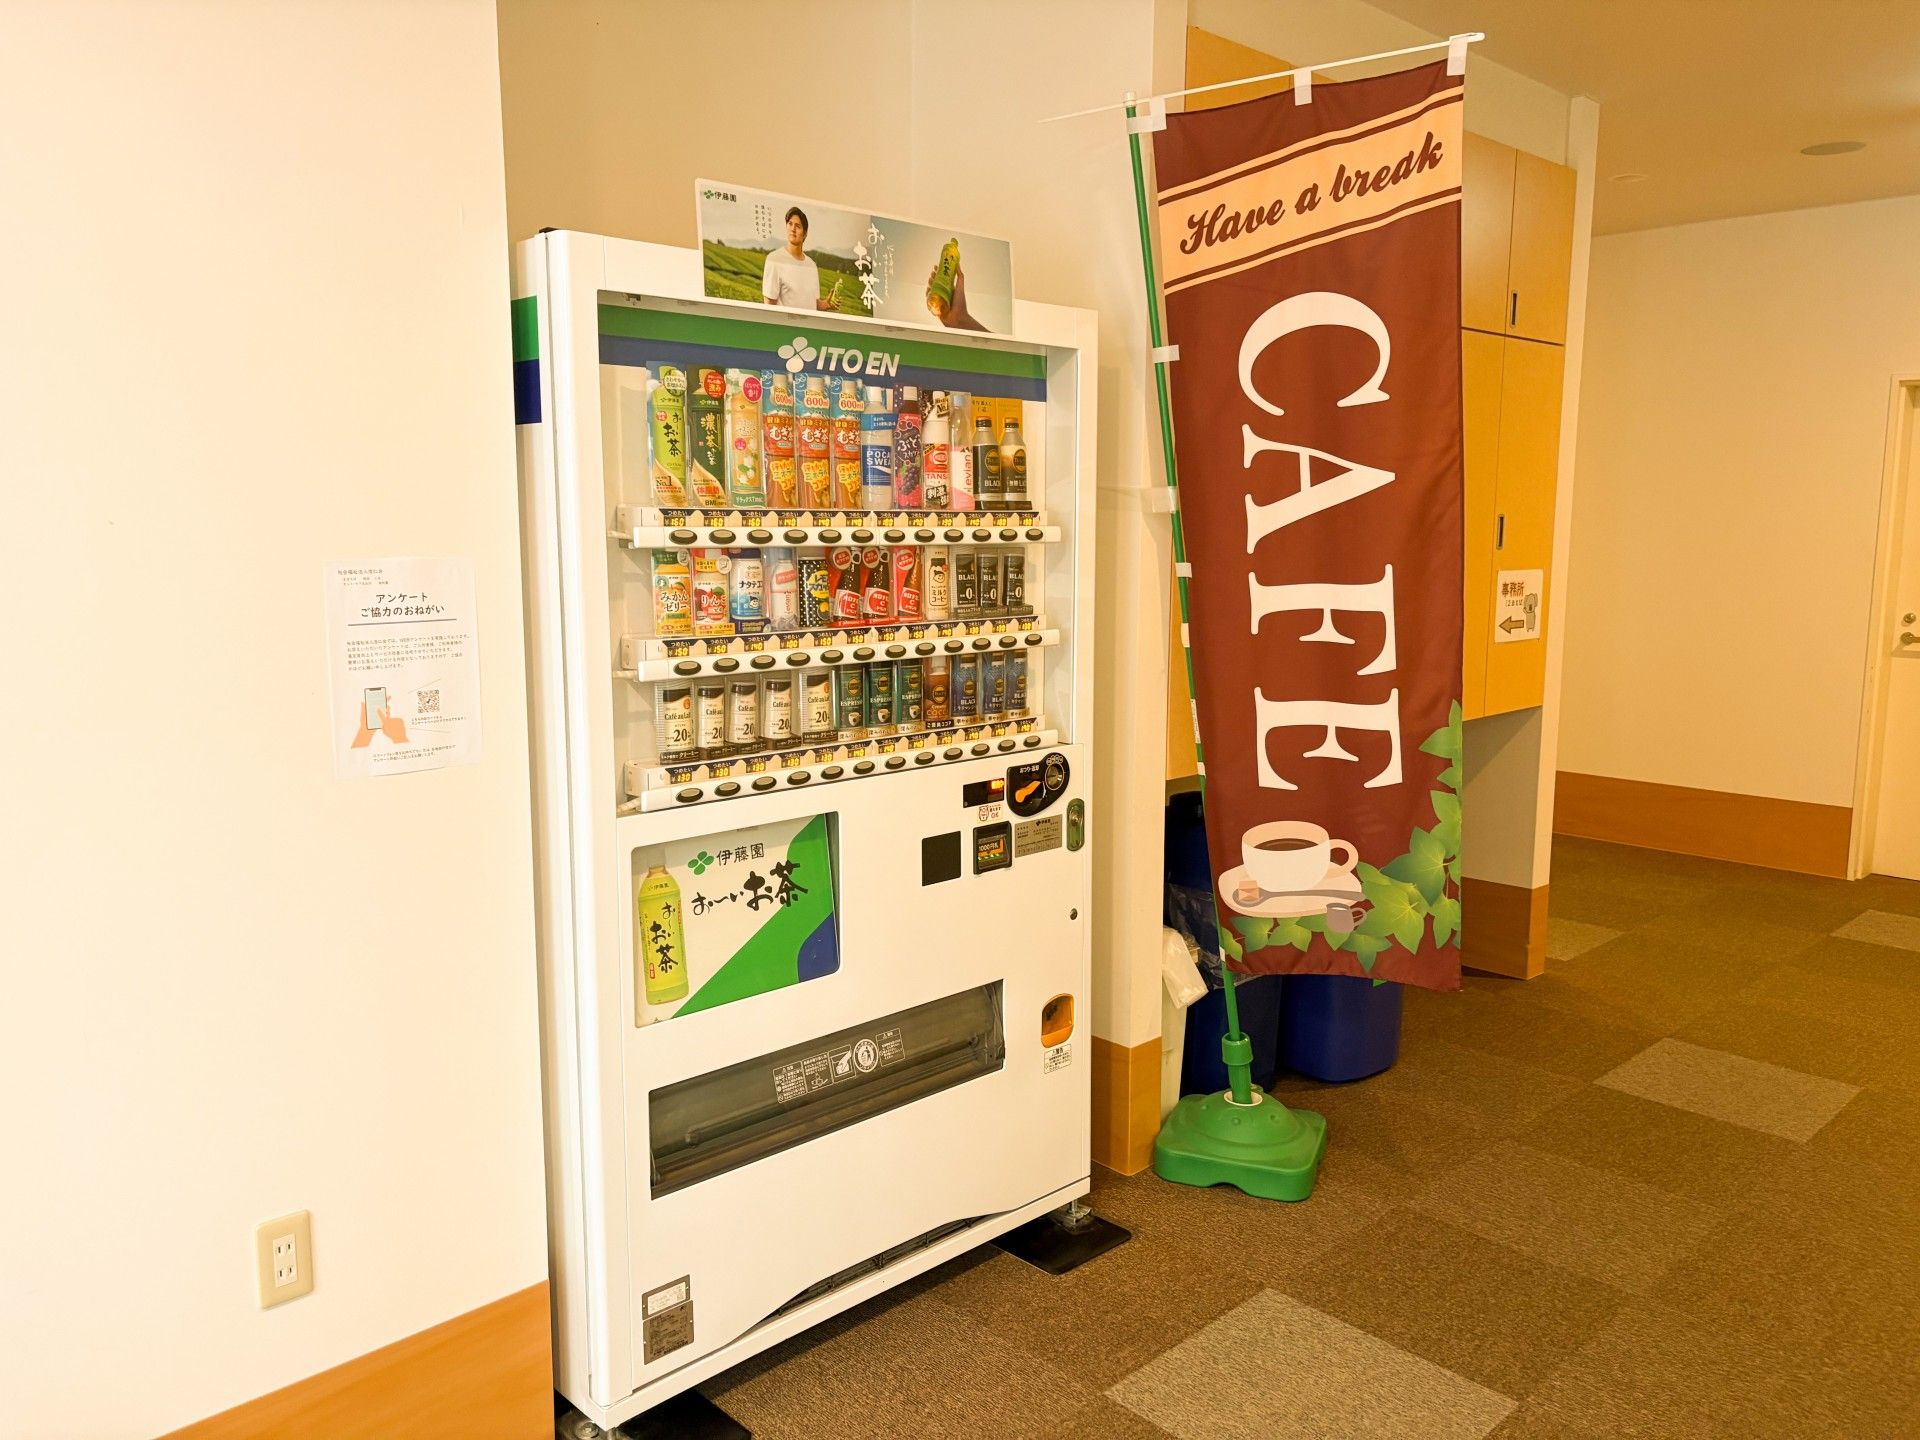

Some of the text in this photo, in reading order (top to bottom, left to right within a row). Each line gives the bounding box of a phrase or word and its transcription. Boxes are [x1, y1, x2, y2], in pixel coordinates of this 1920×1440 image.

[1180, 131, 1444, 255] Have a break
[816, 346, 900, 378] ITO EN
[1238, 290, 1403, 791] CAFE
[376, 592, 428, 604] アンケート
[361, 604, 445, 618] ご協力のおねがい
[815, 711, 827, 723] 20
[674, 729, 687, 742] 20
[716, 842, 765, 869] 伊藤園
